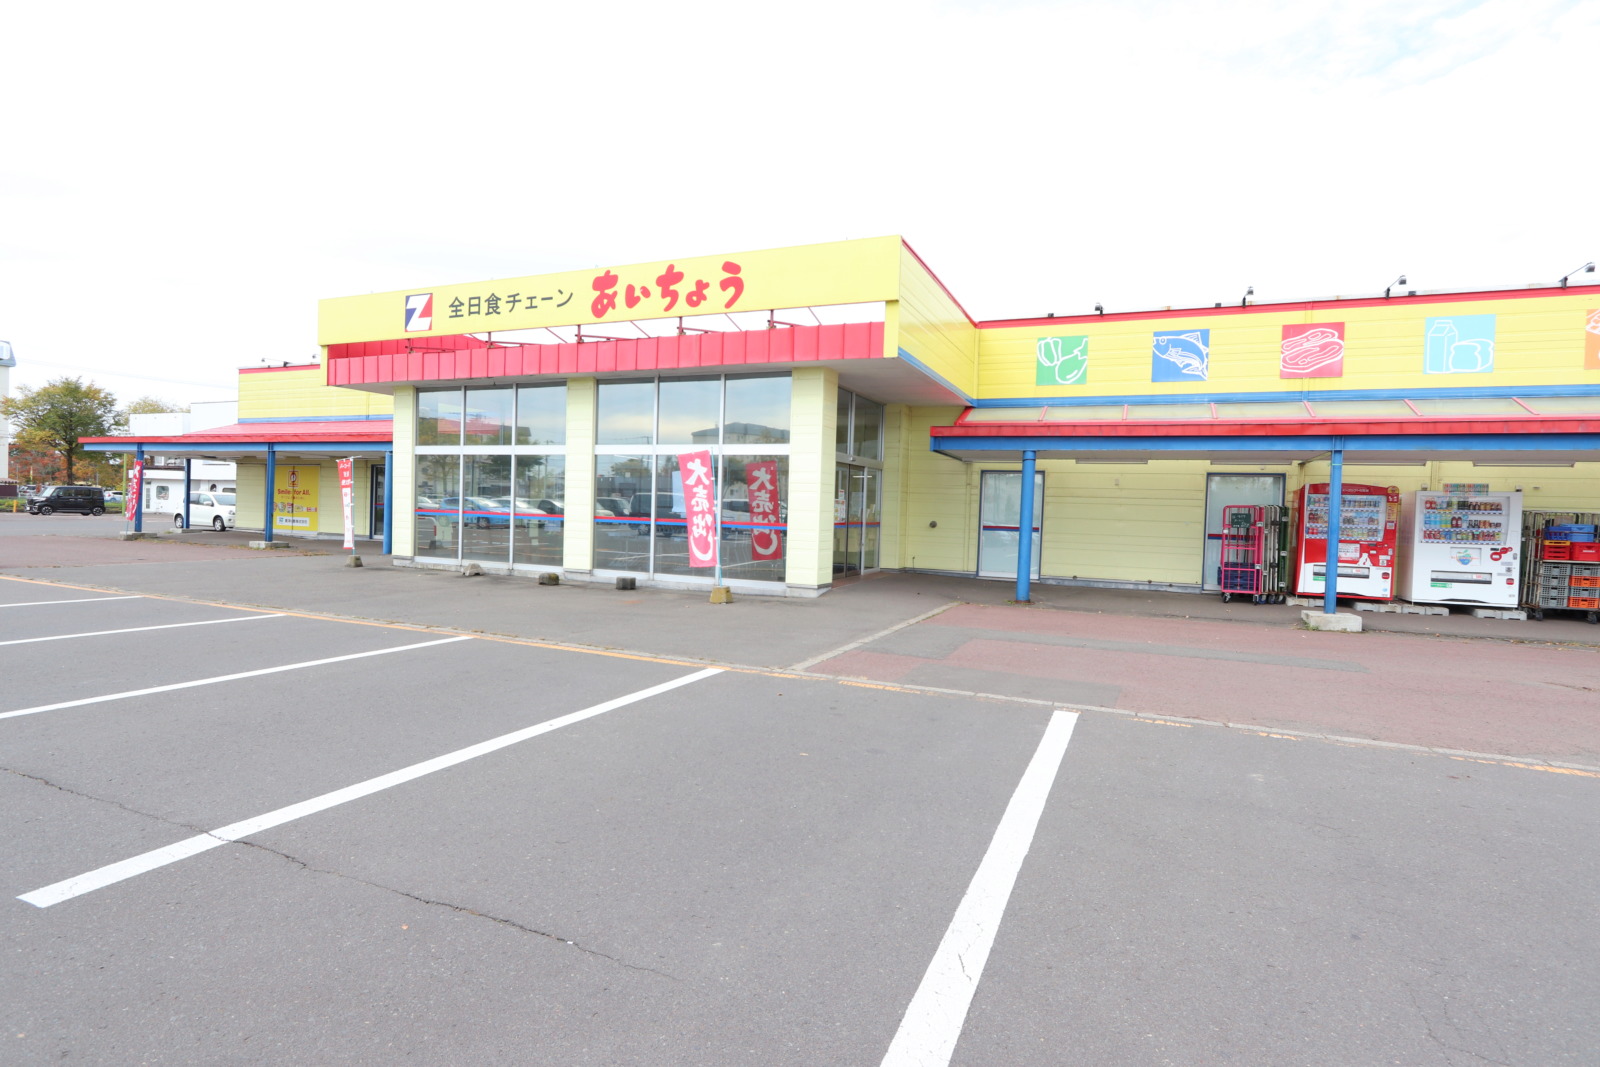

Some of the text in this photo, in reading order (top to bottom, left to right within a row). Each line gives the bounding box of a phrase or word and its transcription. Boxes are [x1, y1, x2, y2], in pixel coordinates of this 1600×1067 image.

[448, 288, 574, 319] 全日食チェーン
[590, 260, 745, 319] あいちょう
